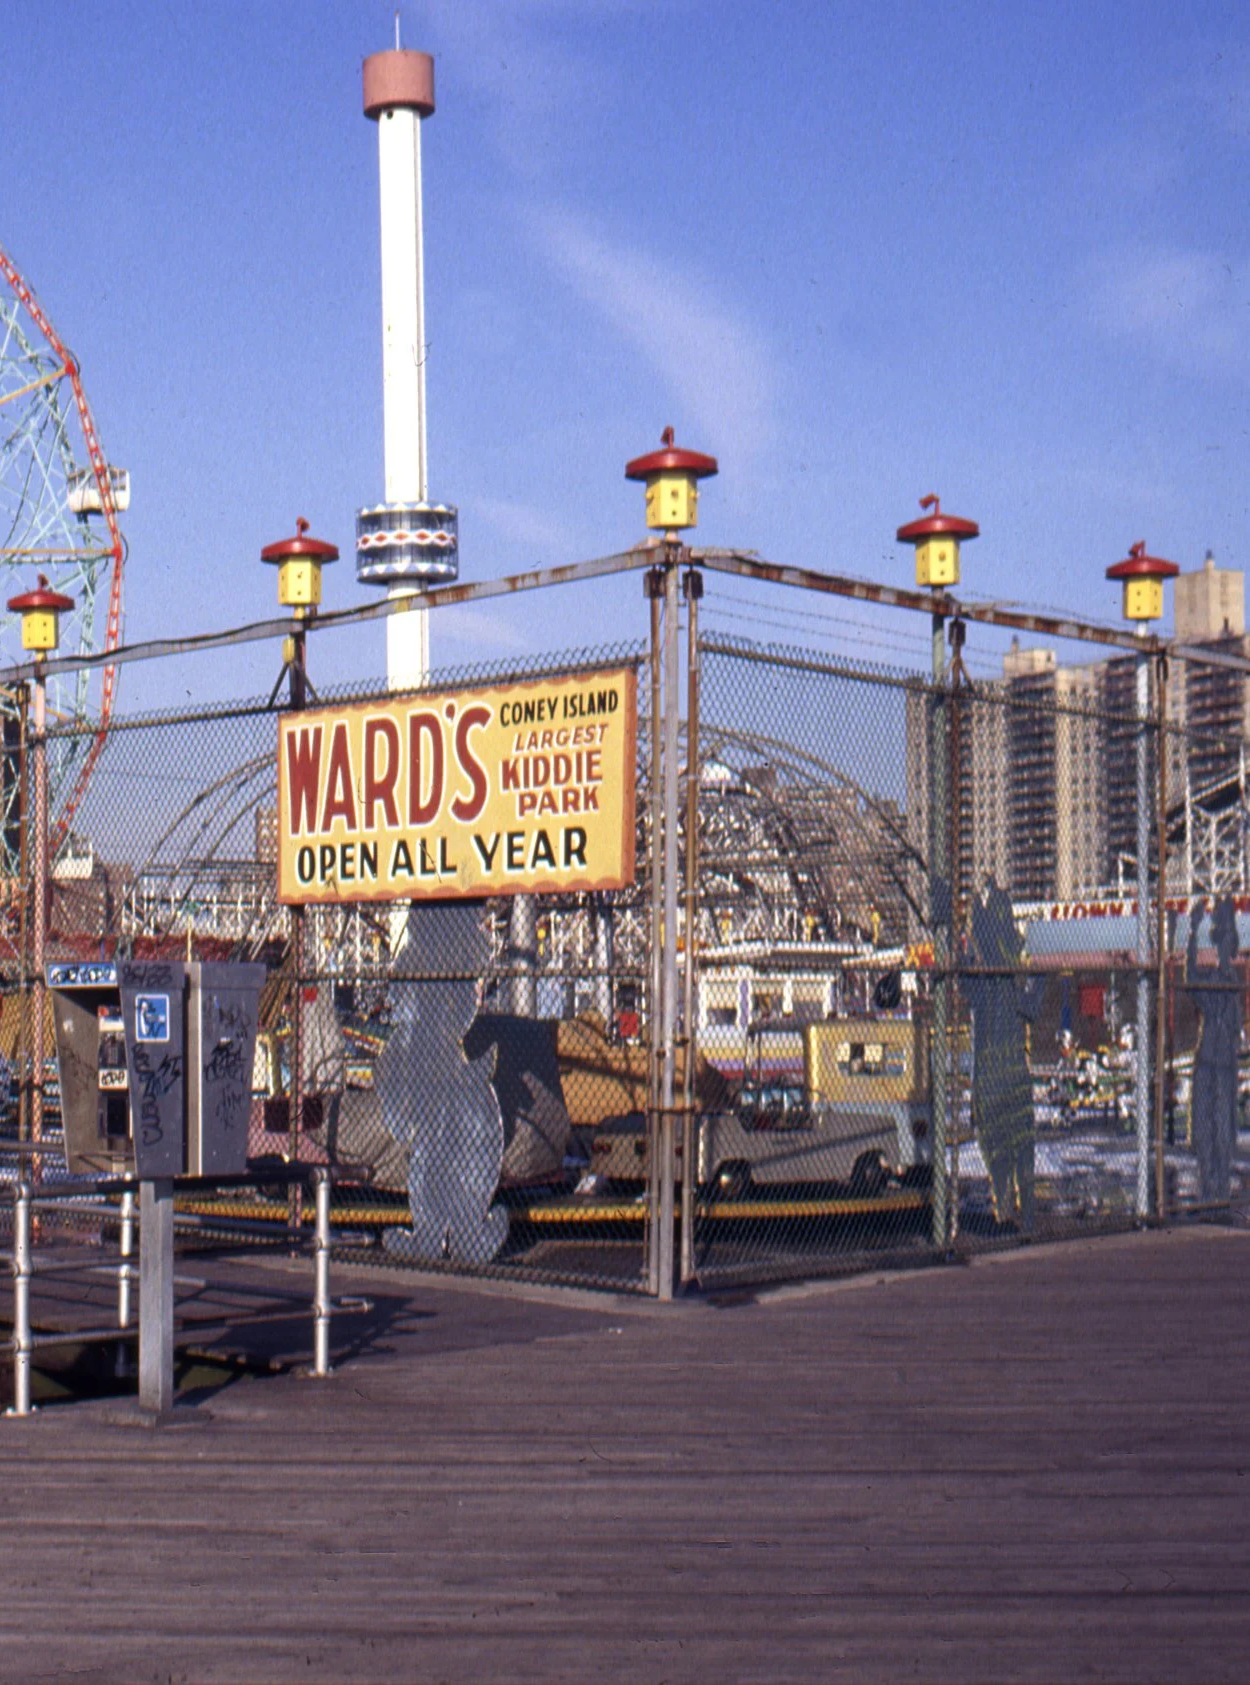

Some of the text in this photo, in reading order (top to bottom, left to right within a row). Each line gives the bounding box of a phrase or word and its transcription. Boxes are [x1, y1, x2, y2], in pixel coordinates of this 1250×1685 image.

[500, 689, 619, 728] CONEY ISLAND
[514, 723, 608, 752] LARGEST
[286, 701, 492, 836] WARD'S
[501, 749, 604, 791] KIDDIE
[517, 785, 600, 818] PARK
[297, 826, 588, 884] OPEN ALL YEAR
